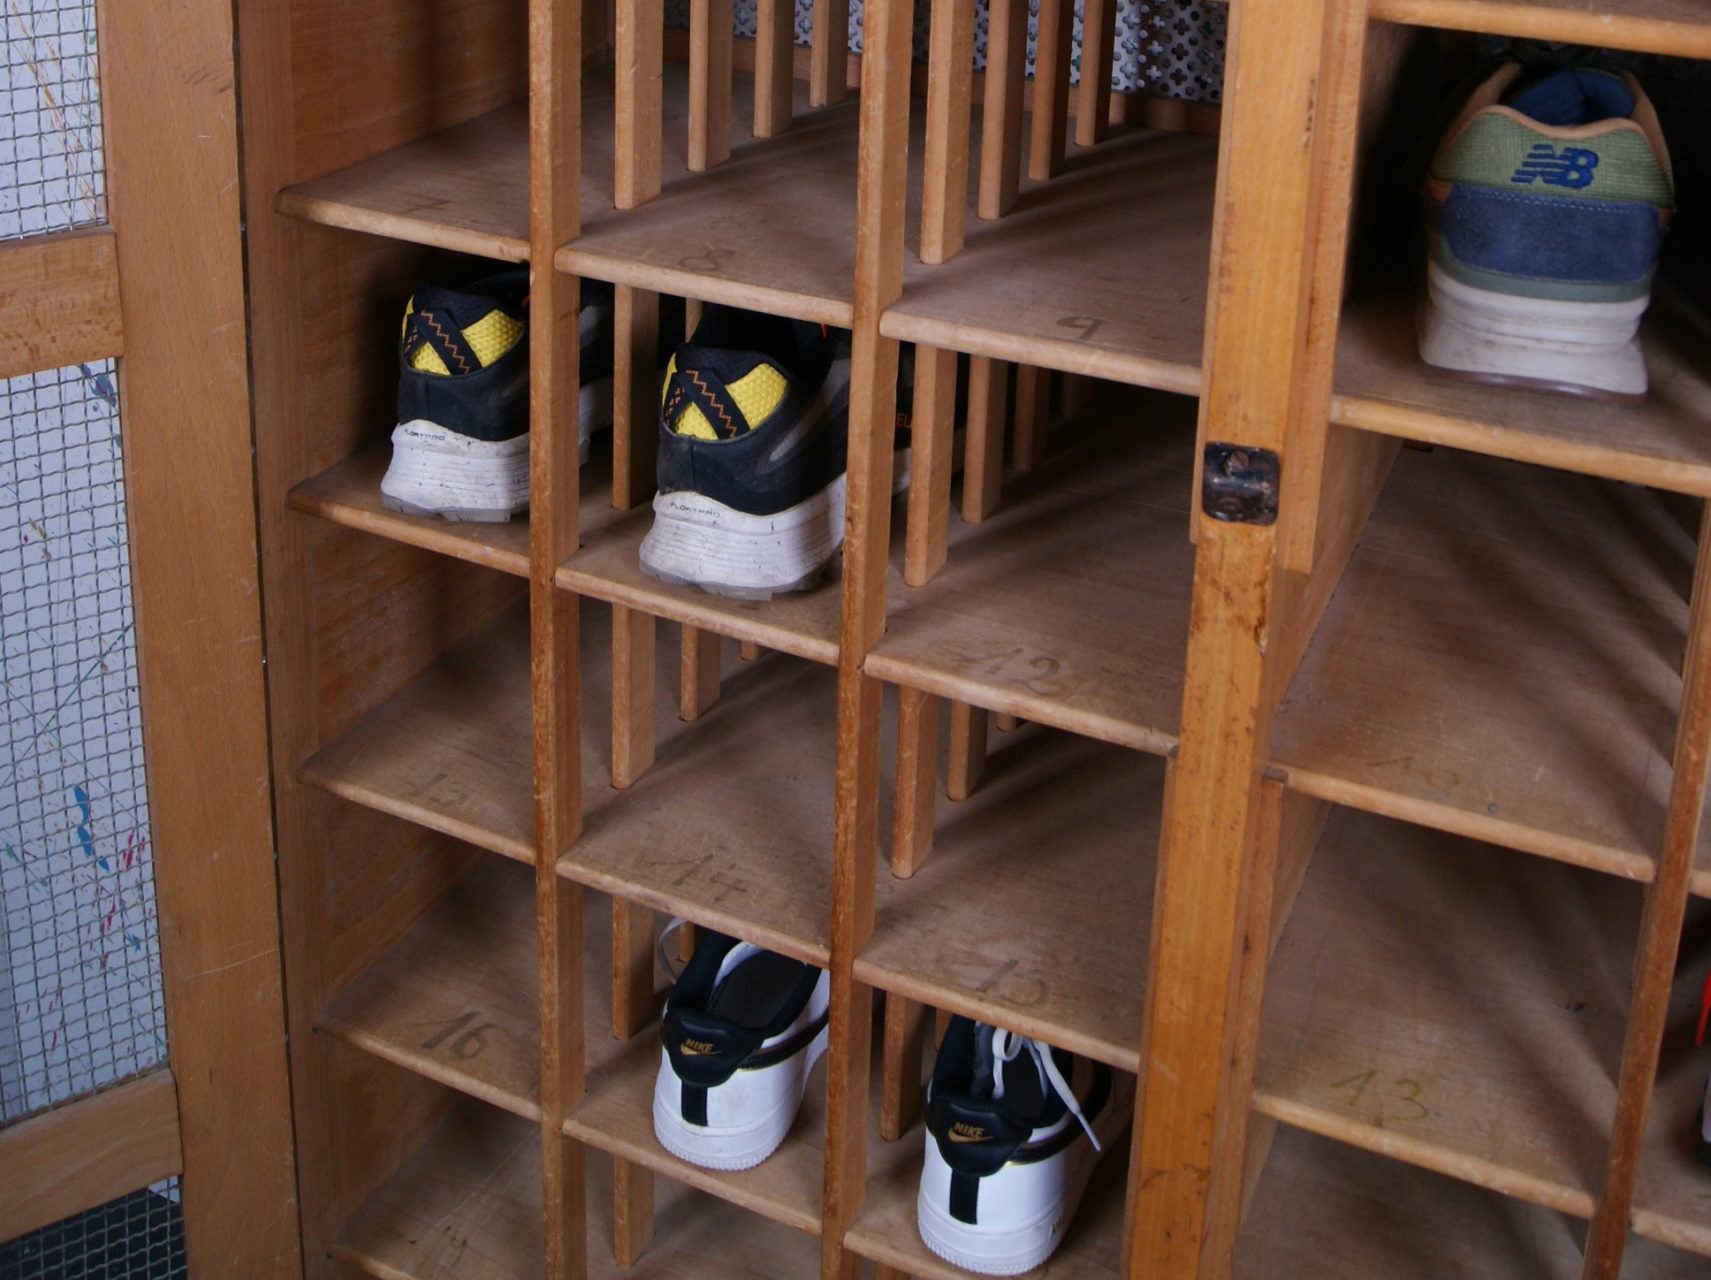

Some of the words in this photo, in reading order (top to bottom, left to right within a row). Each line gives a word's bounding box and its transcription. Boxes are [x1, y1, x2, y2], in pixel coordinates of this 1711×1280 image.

[676, 248, 735, 272] 8
[1056, 316, 1106, 341] 9
[419, 1010, 496, 1060] 16
[685, 1038, 714, 1053] NIKE
[1330, 1070, 1426, 1122] 13
[953, 1122, 984, 1138] NIKE
